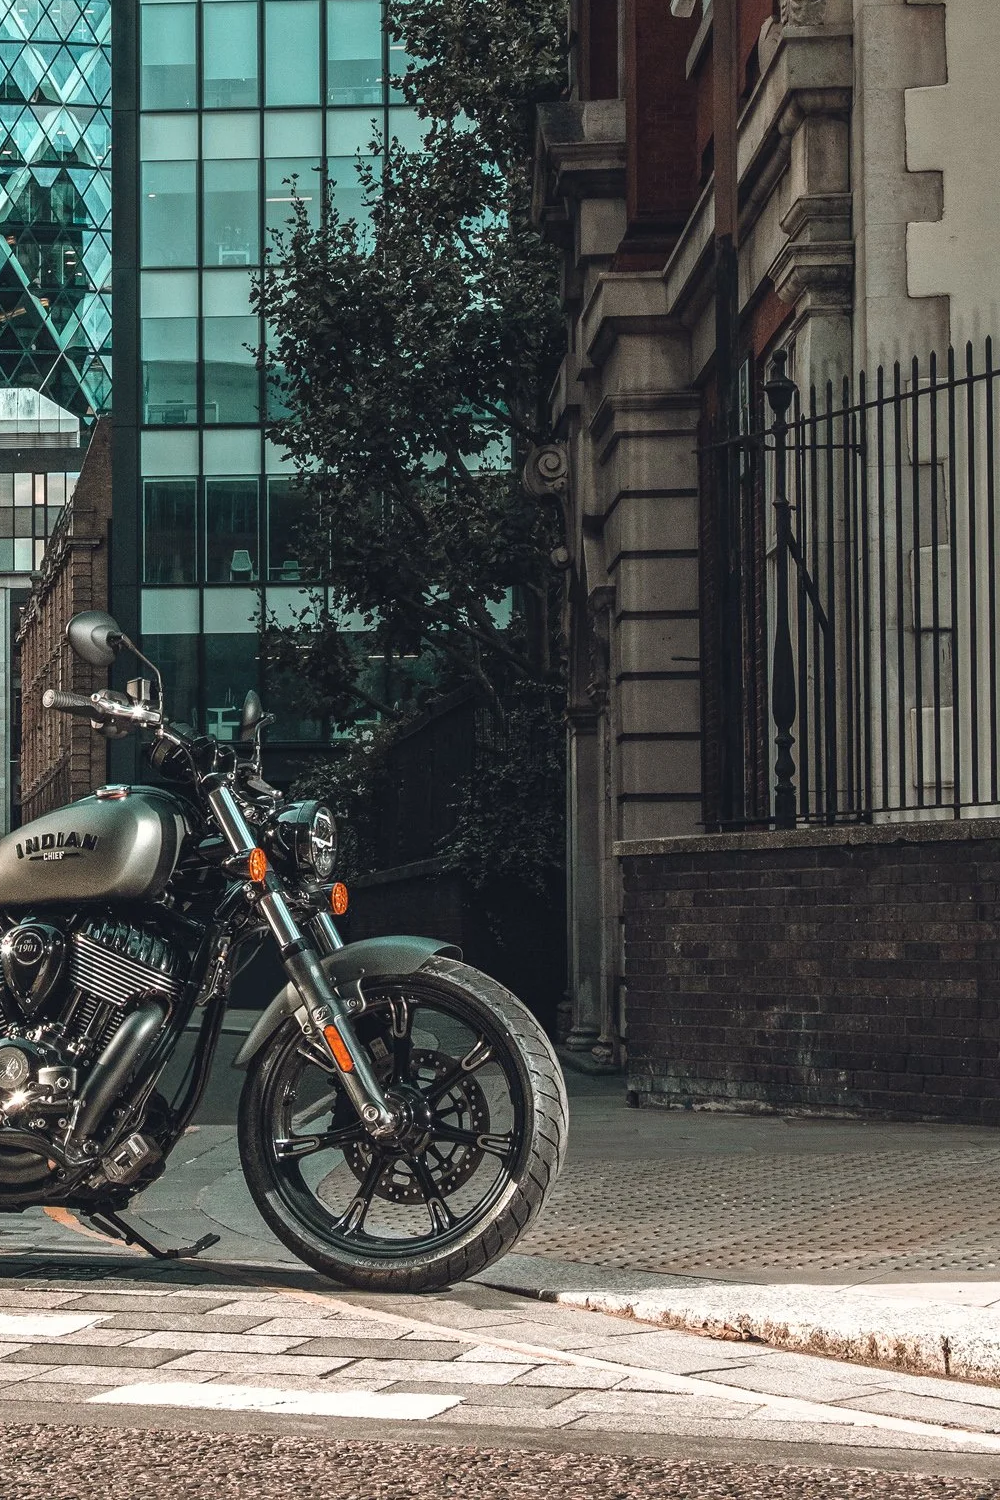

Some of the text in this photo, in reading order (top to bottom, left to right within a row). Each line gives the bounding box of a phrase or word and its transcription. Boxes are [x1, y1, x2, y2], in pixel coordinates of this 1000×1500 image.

[15, 831, 99, 859] INDIAN
[43, 851, 65, 861] CHIEF
[18, 944, 37, 952] 1901
